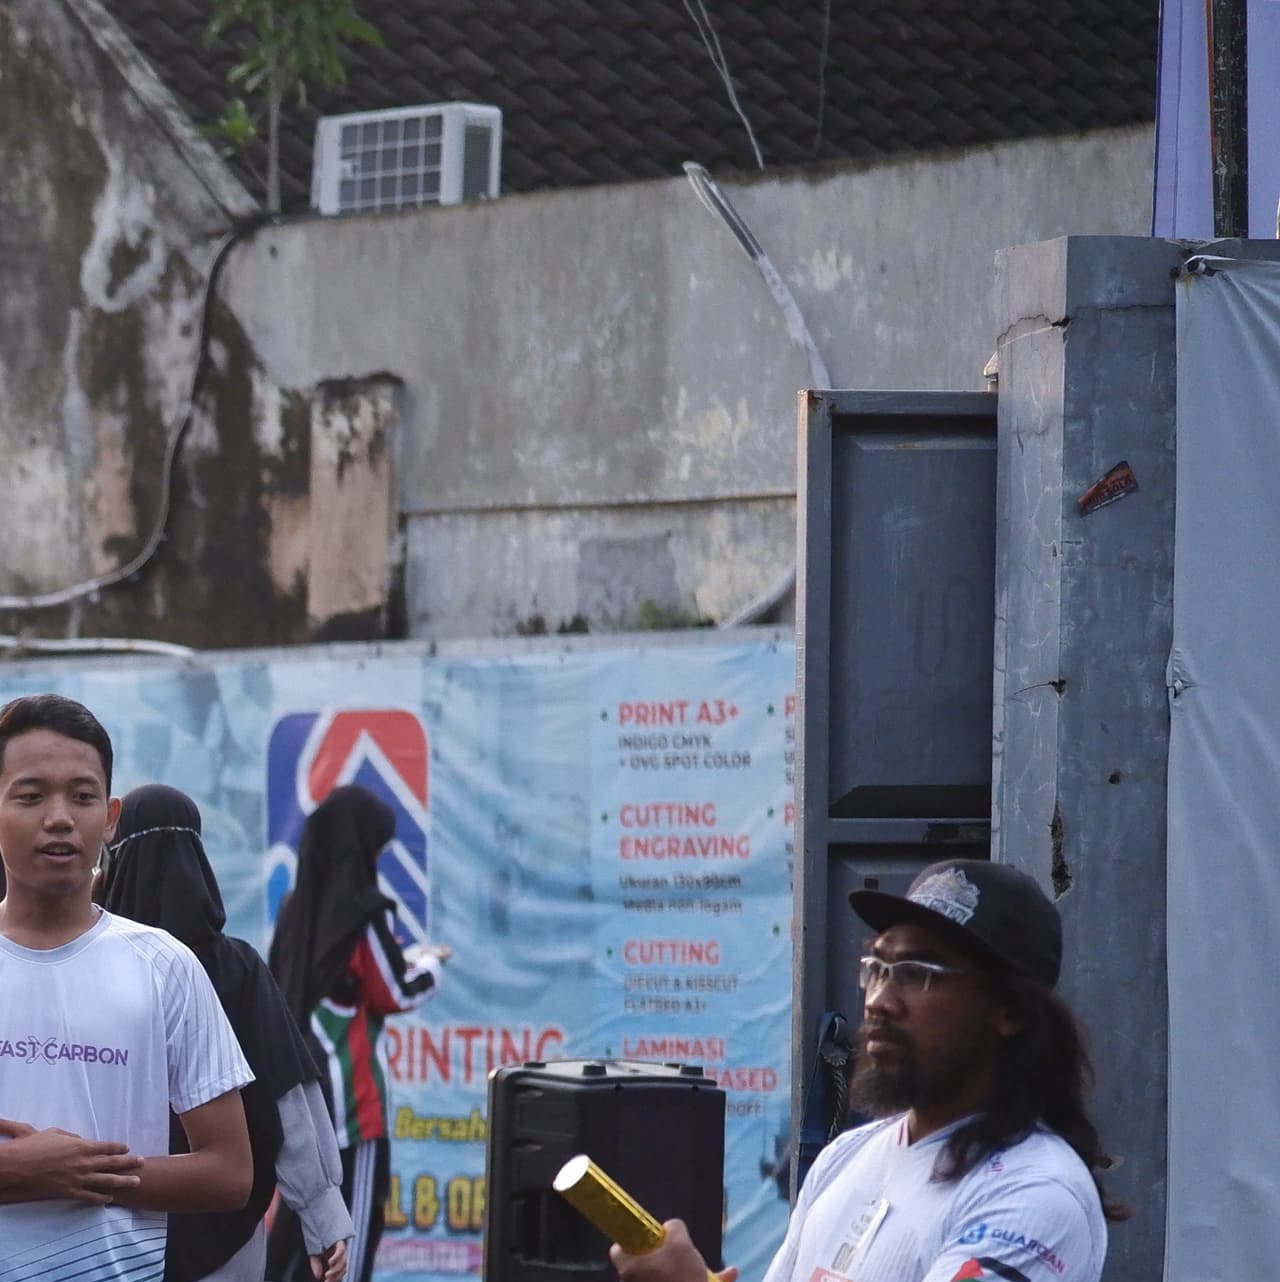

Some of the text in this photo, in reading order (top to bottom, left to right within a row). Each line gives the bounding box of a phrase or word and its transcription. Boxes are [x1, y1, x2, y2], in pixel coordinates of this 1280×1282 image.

[619, 699, 739, 726] PRINT A3+
[619, 803, 716, 828] CUTTING
[619, 834, 751, 860] ENGRAVING
[624, 939, 720, 965] CUTTING
[386, 1026, 564, 1085] RINTING
[623, 1036, 725, 1060] LAMINASI
[395, 1106, 488, 1140] Bersah
[991, 1228, 1067, 1274] GUARDIAN
